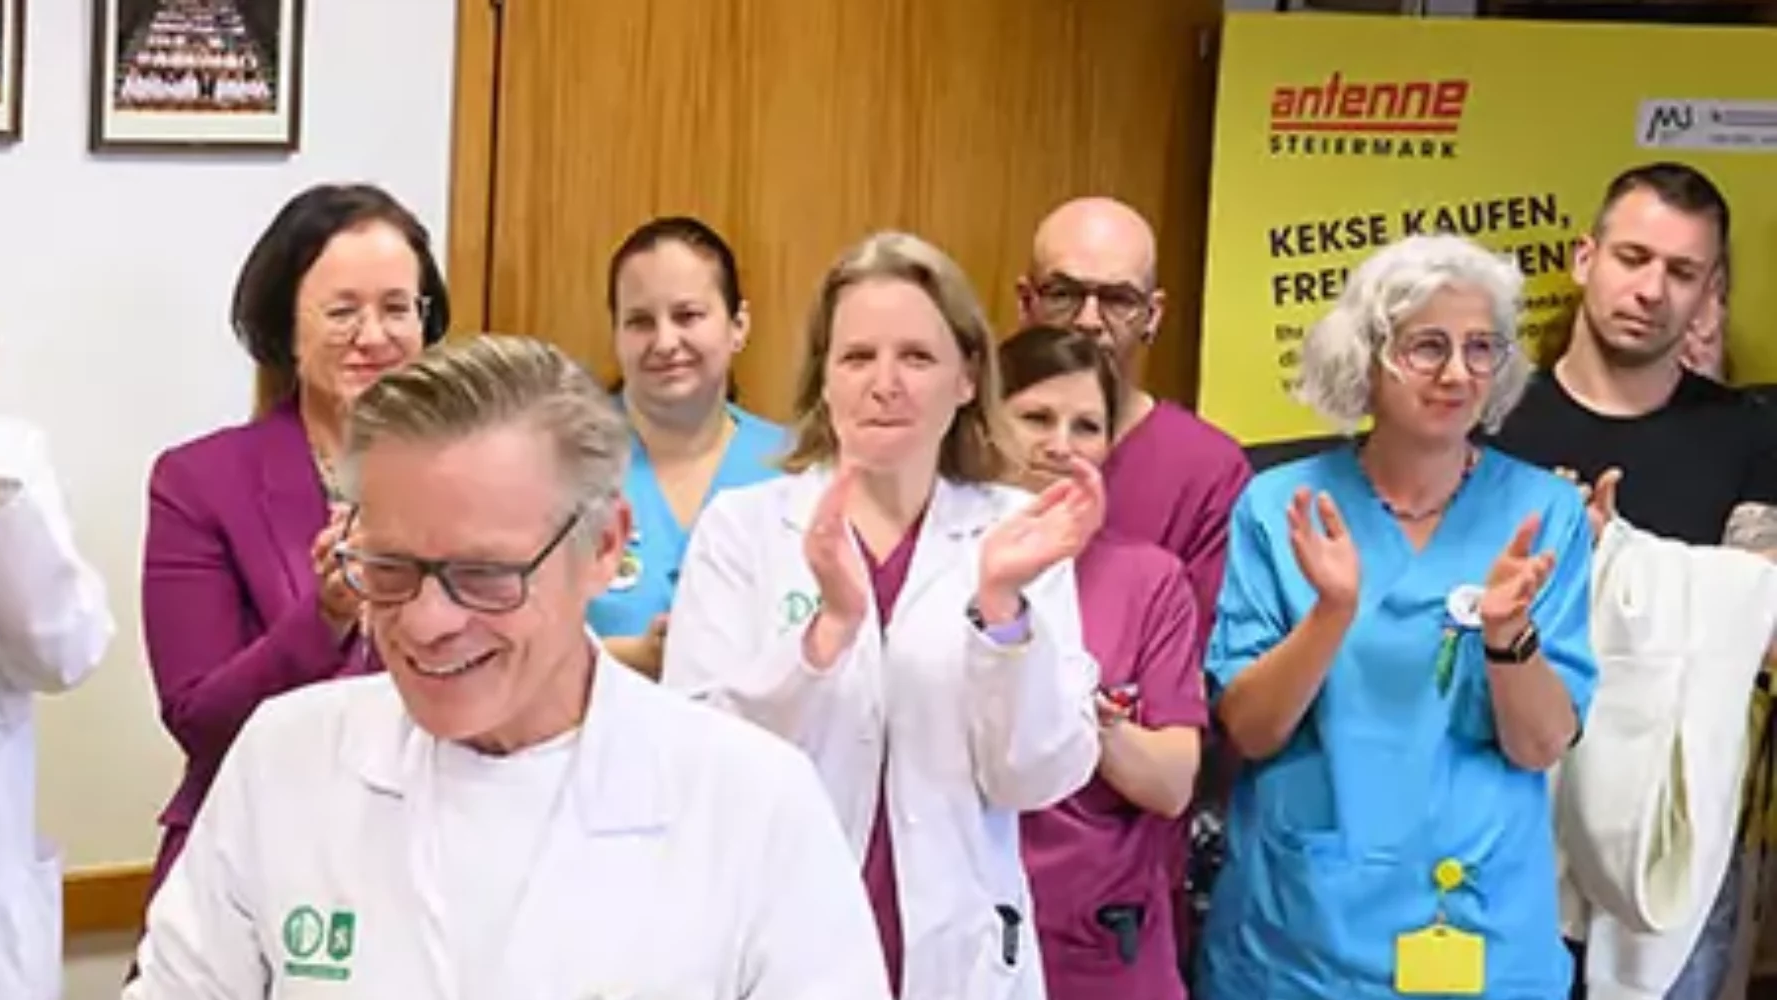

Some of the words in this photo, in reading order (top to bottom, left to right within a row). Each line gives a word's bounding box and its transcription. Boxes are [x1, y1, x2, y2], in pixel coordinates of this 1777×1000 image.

[1270, 71, 1469, 119] antenne
[1270, 134, 1458, 159] STEIERMARK
[1269, 215, 1388, 258] KEKSE
[1403, 194, 1570, 237] KAUFEN,
